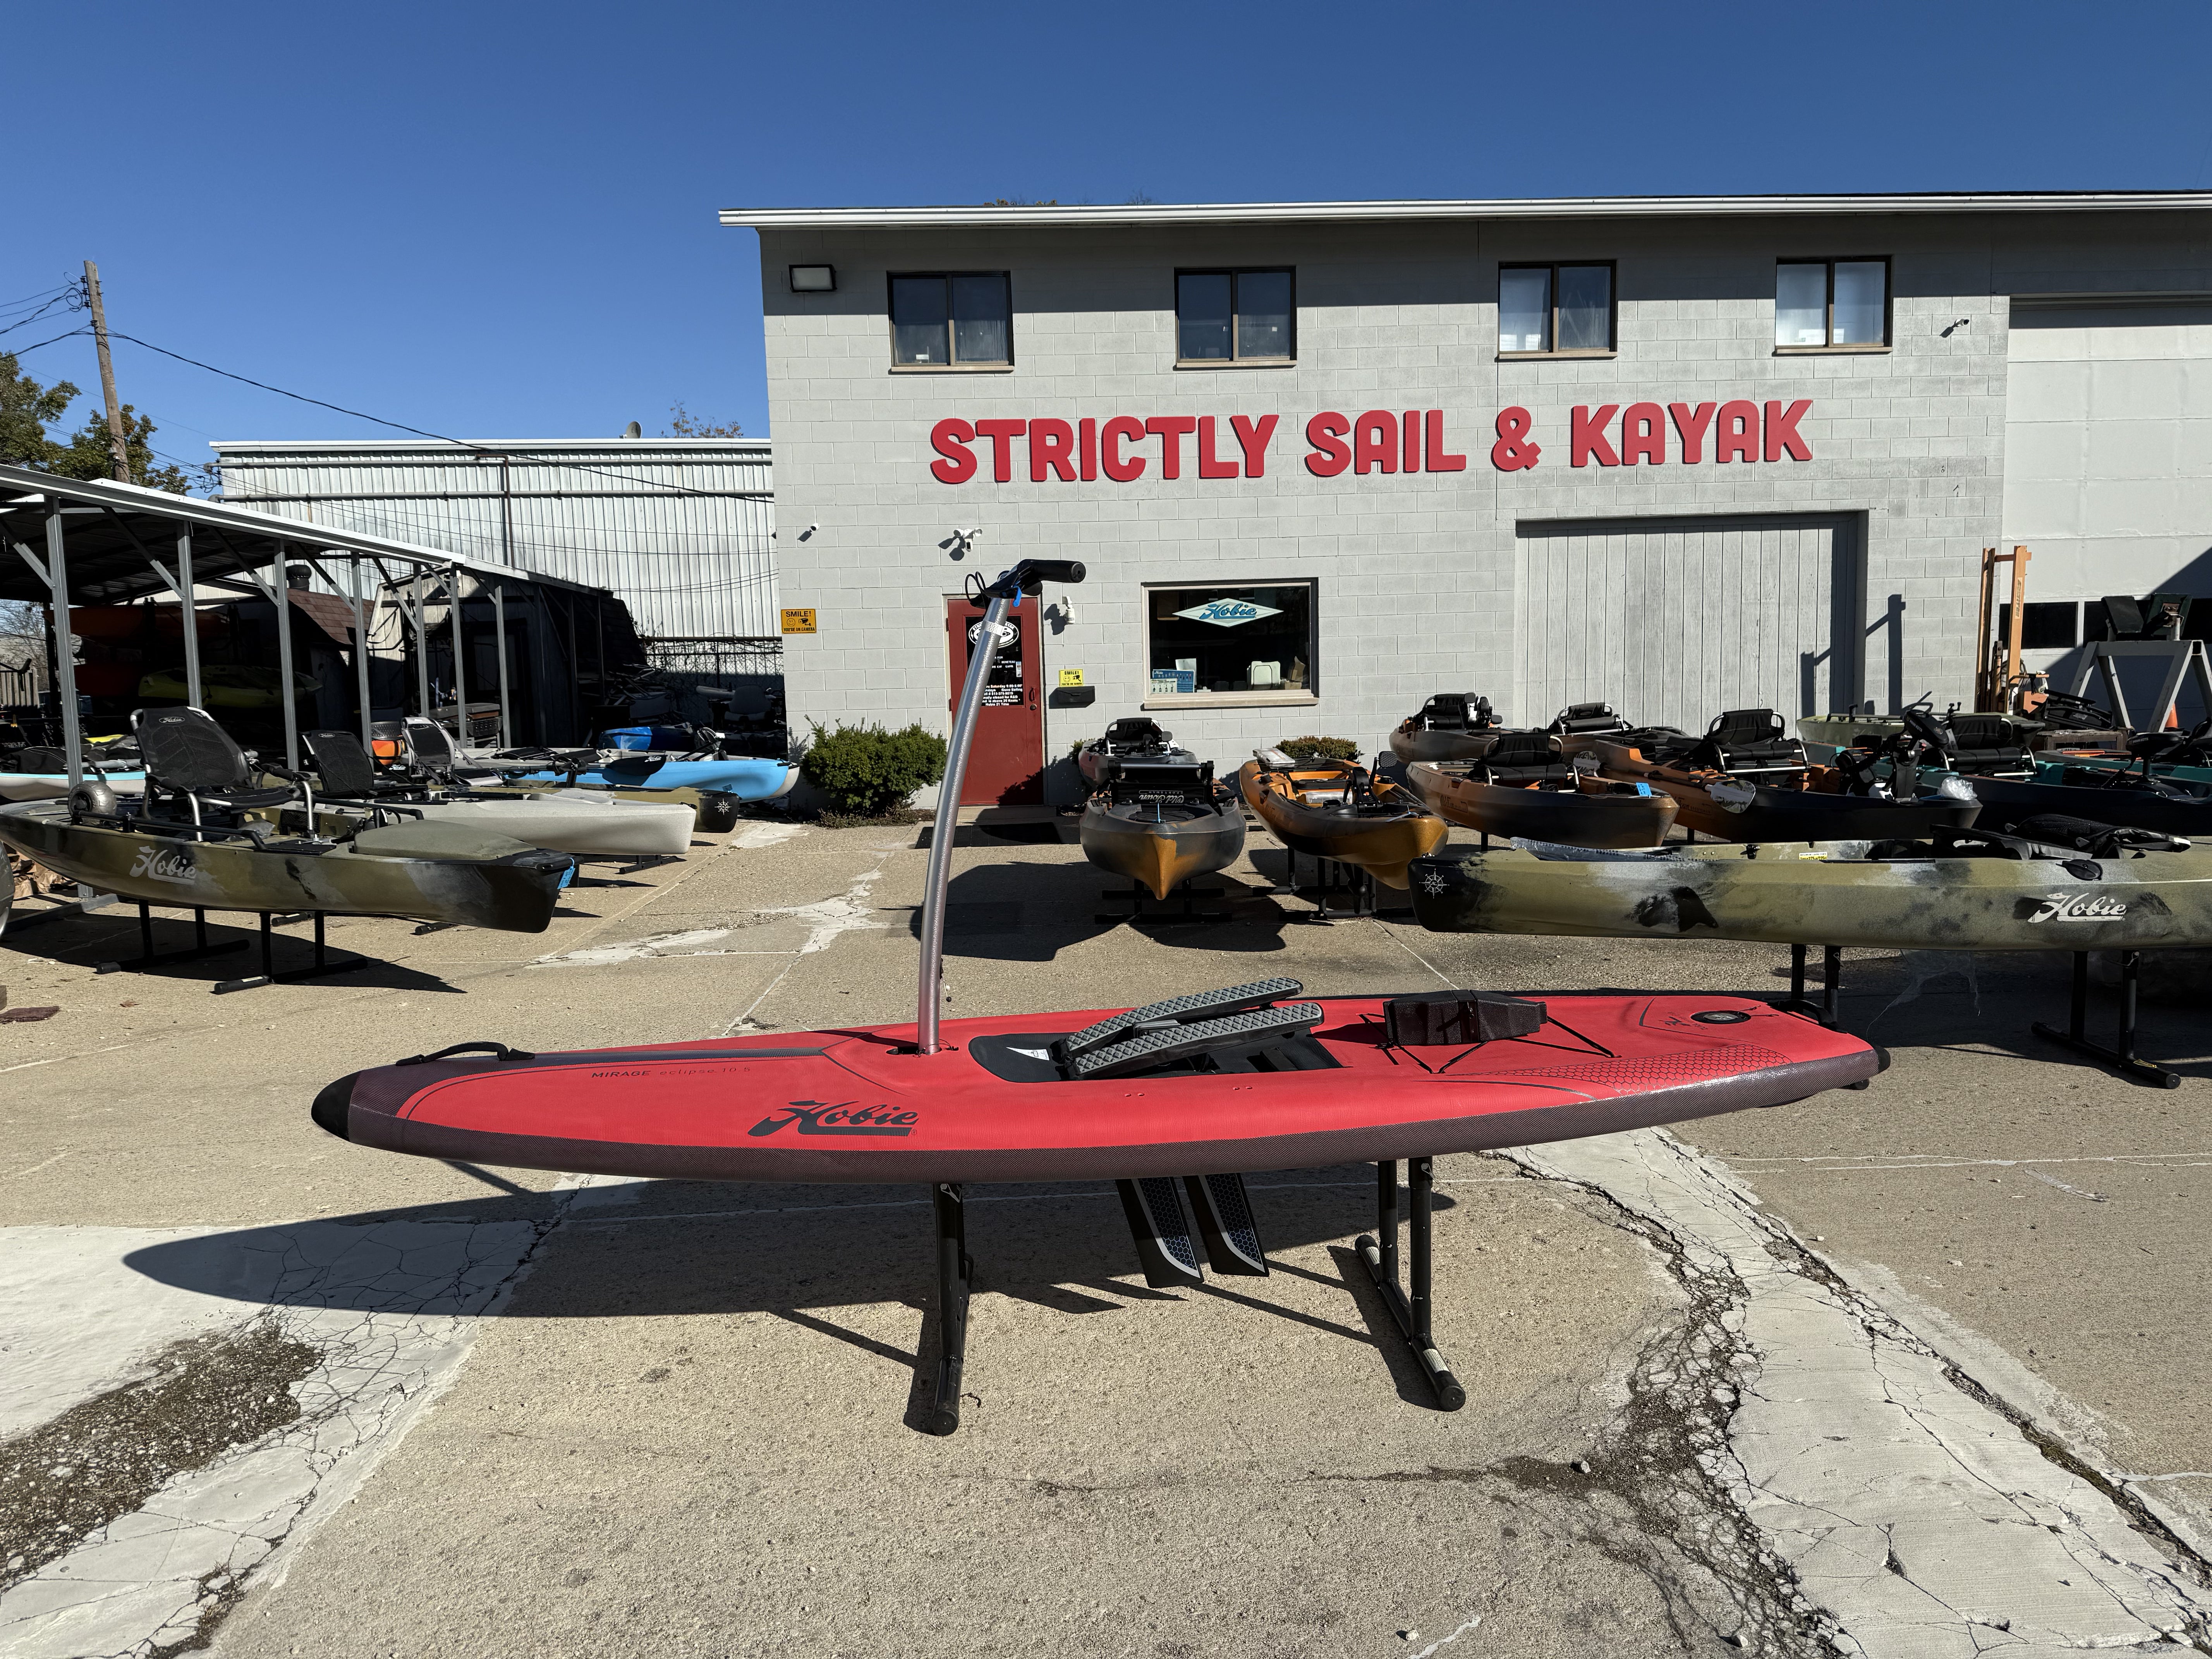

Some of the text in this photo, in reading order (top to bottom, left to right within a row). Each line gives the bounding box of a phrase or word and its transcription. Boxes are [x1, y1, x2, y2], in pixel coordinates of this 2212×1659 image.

[932, 400, 1811, 483] STRICTLY SAIL & KAYAK
[1199, 603, 1257, 619] Hobie
[129, 846, 197, 885] Hobie
[2027, 892, 2127, 923] Hobie
[748, 1100, 919, 1137] Hobie
